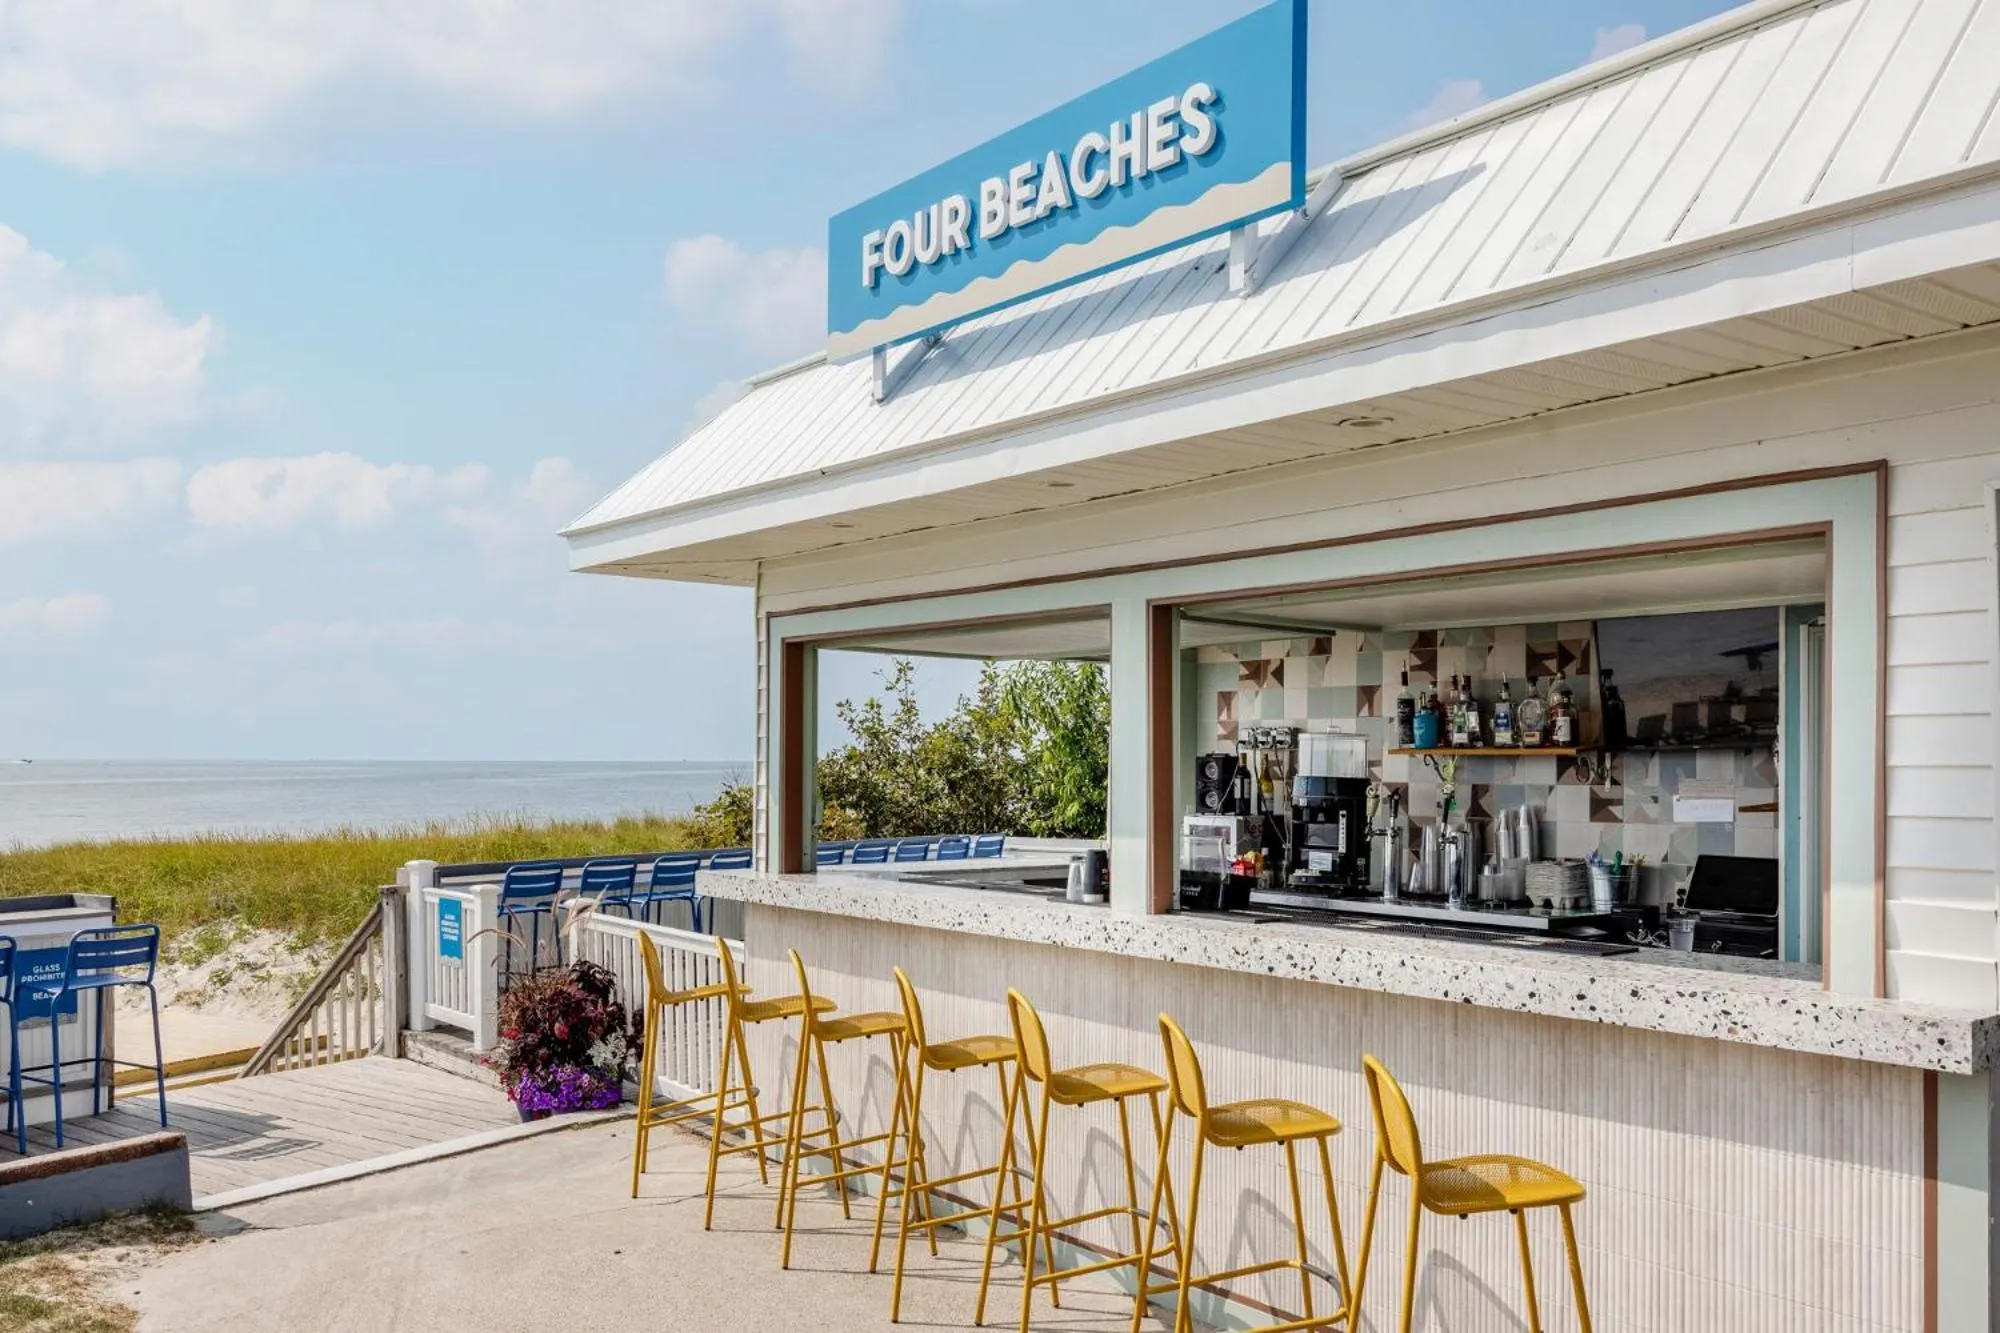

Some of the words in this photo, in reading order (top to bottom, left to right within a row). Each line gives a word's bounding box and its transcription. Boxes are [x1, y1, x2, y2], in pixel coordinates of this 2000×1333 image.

[862, 194, 972, 287] FOUR
[979, 82, 1219, 241] BEACHES
[32, 963, 61, 973] GLASS
[21, 971, 65, 983] PROHIBITE
